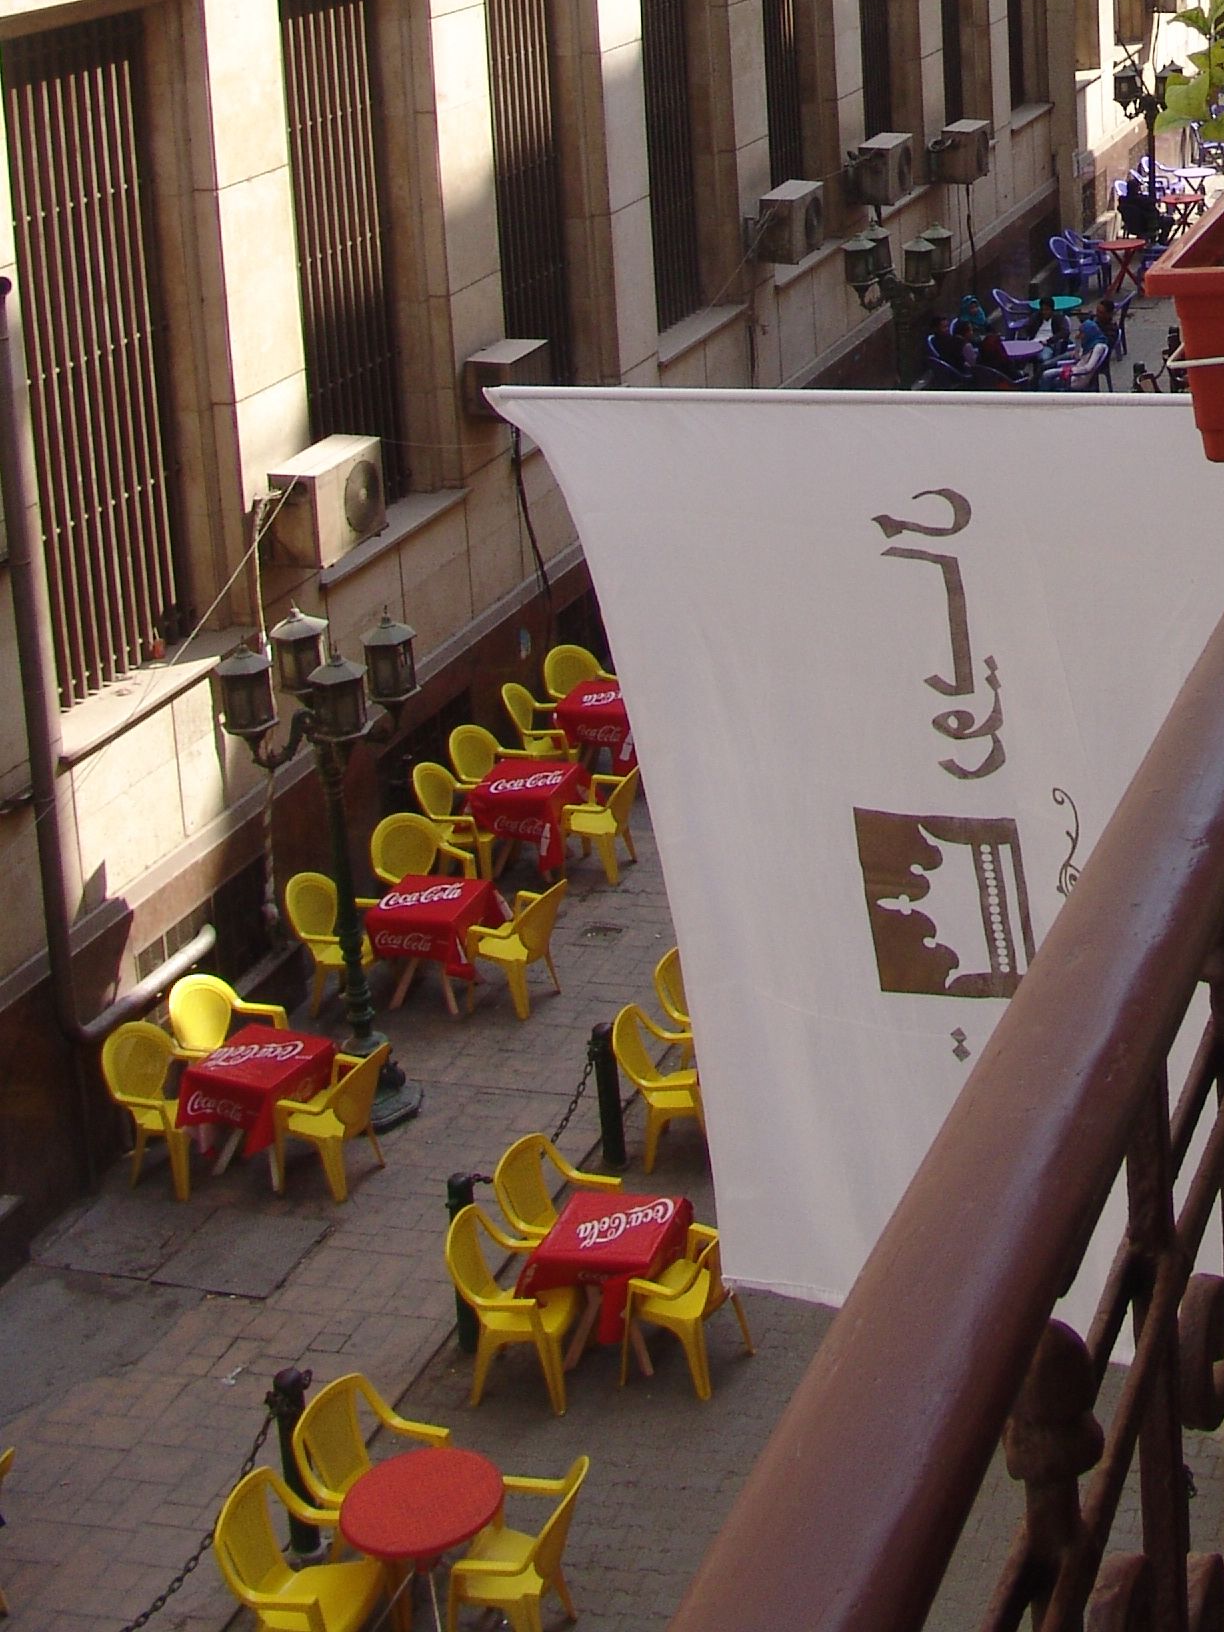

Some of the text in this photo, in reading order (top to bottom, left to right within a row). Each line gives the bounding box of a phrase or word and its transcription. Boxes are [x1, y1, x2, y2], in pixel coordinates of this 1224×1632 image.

[489, 770, 564, 794] Coca-Cola
[378, 882, 465, 910] Coca-Cola
[374, 930, 432, 952] Coca-Cola
[576, 1198, 675, 1249] Coca-Cola
